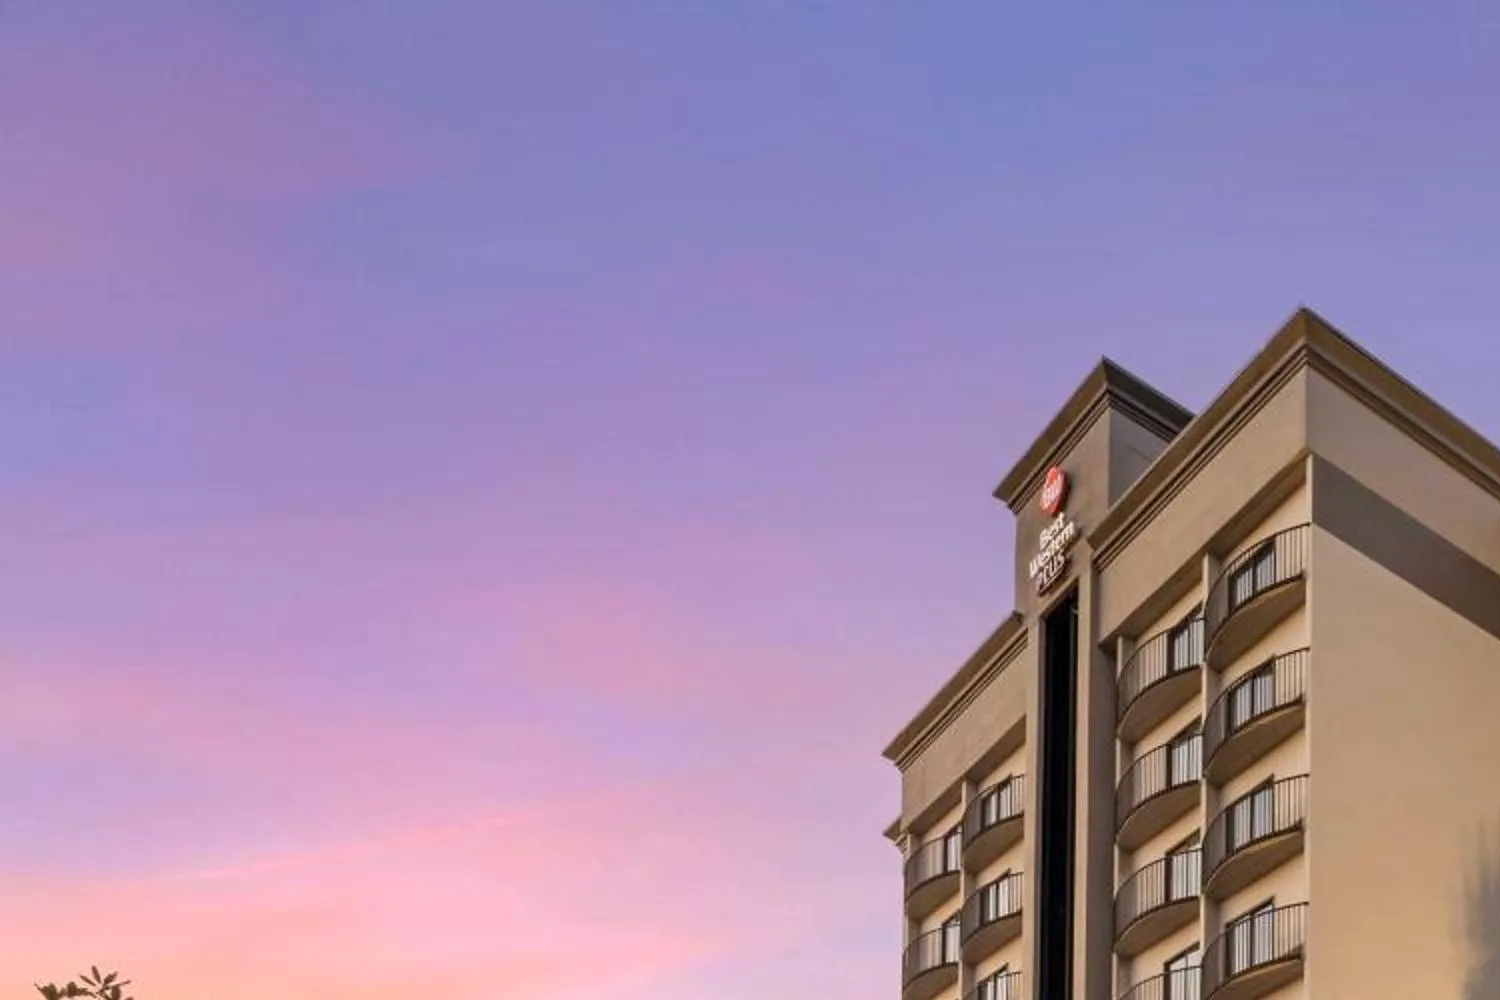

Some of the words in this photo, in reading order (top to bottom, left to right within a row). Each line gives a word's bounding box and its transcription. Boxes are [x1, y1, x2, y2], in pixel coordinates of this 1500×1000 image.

[1029, 521, 1074, 578] Western
[1040, 512, 1064, 550] Best
[1036, 551, 1065, 593] PLUS
